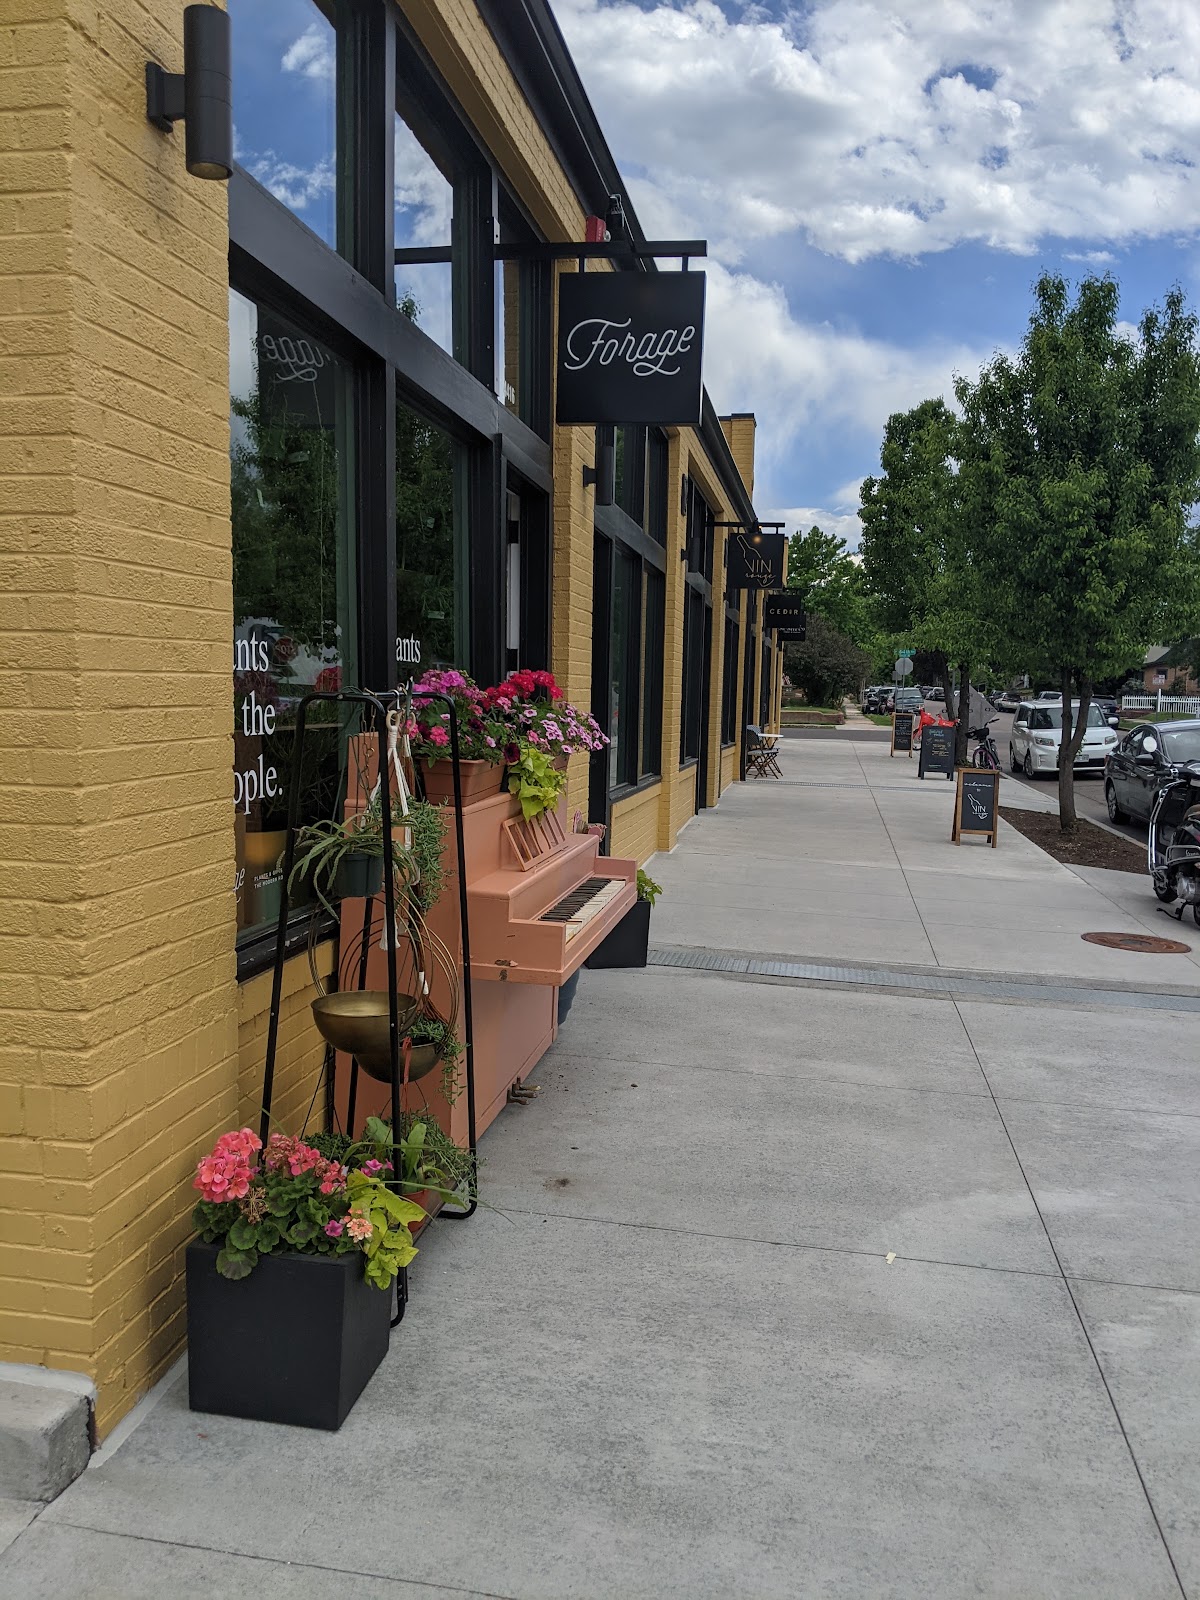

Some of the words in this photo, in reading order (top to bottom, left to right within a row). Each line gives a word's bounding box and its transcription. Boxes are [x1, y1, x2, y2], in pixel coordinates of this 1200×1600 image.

[564, 317, 696, 377] Forage
[744, 559, 772, 573] VIN
[745, 573, 776, 584] rouge
[233, 631, 269, 672] nts
[241, 691, 276, 736] the
